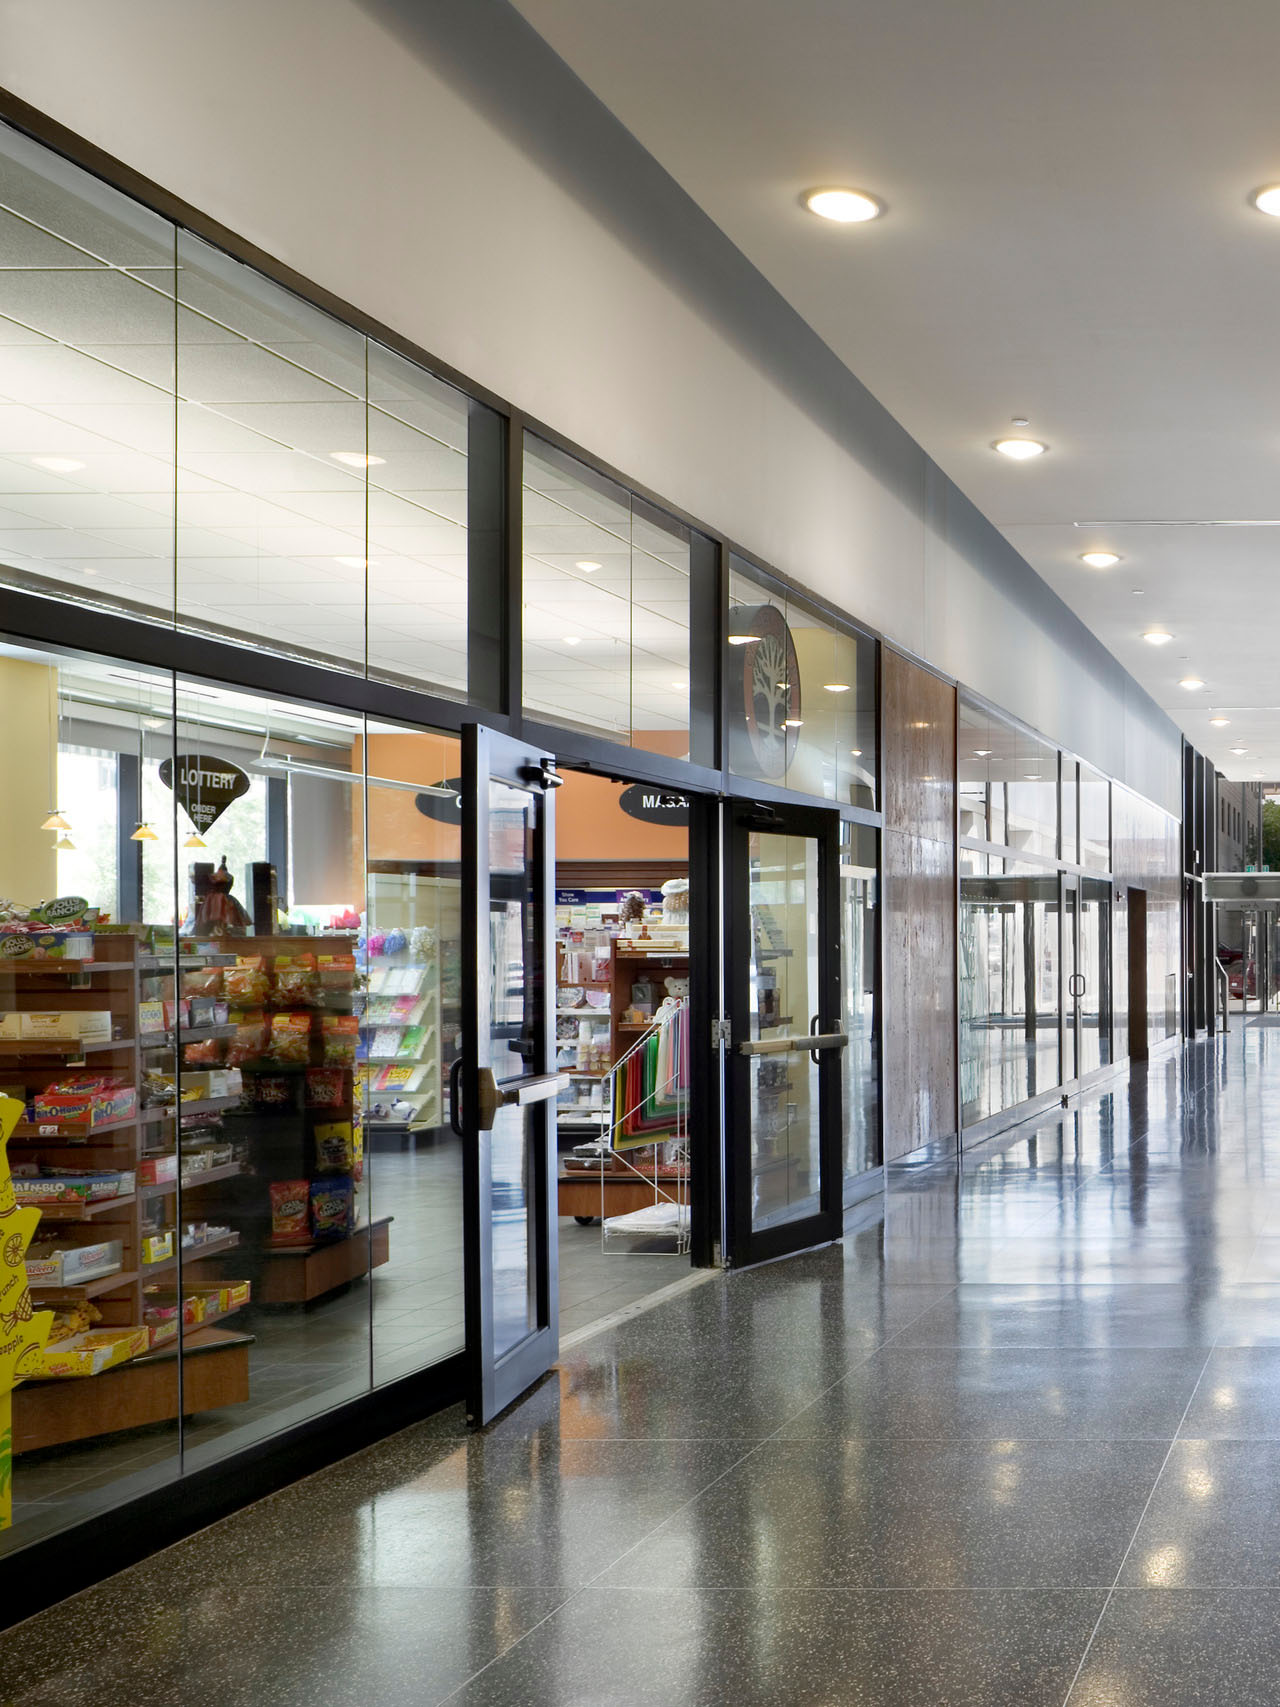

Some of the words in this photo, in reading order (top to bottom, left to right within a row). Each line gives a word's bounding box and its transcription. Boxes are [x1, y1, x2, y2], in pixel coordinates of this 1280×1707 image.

[180, 768, 240, 790] LOTTERY
[642, 794, 690, 808] MAGA
[191, 803, 217, 814] ORDER
[193, 813, 213, 824] HERE
[53, 898, 81, 911] JOLLY
[6, 936, 27, 948] JOLLY
